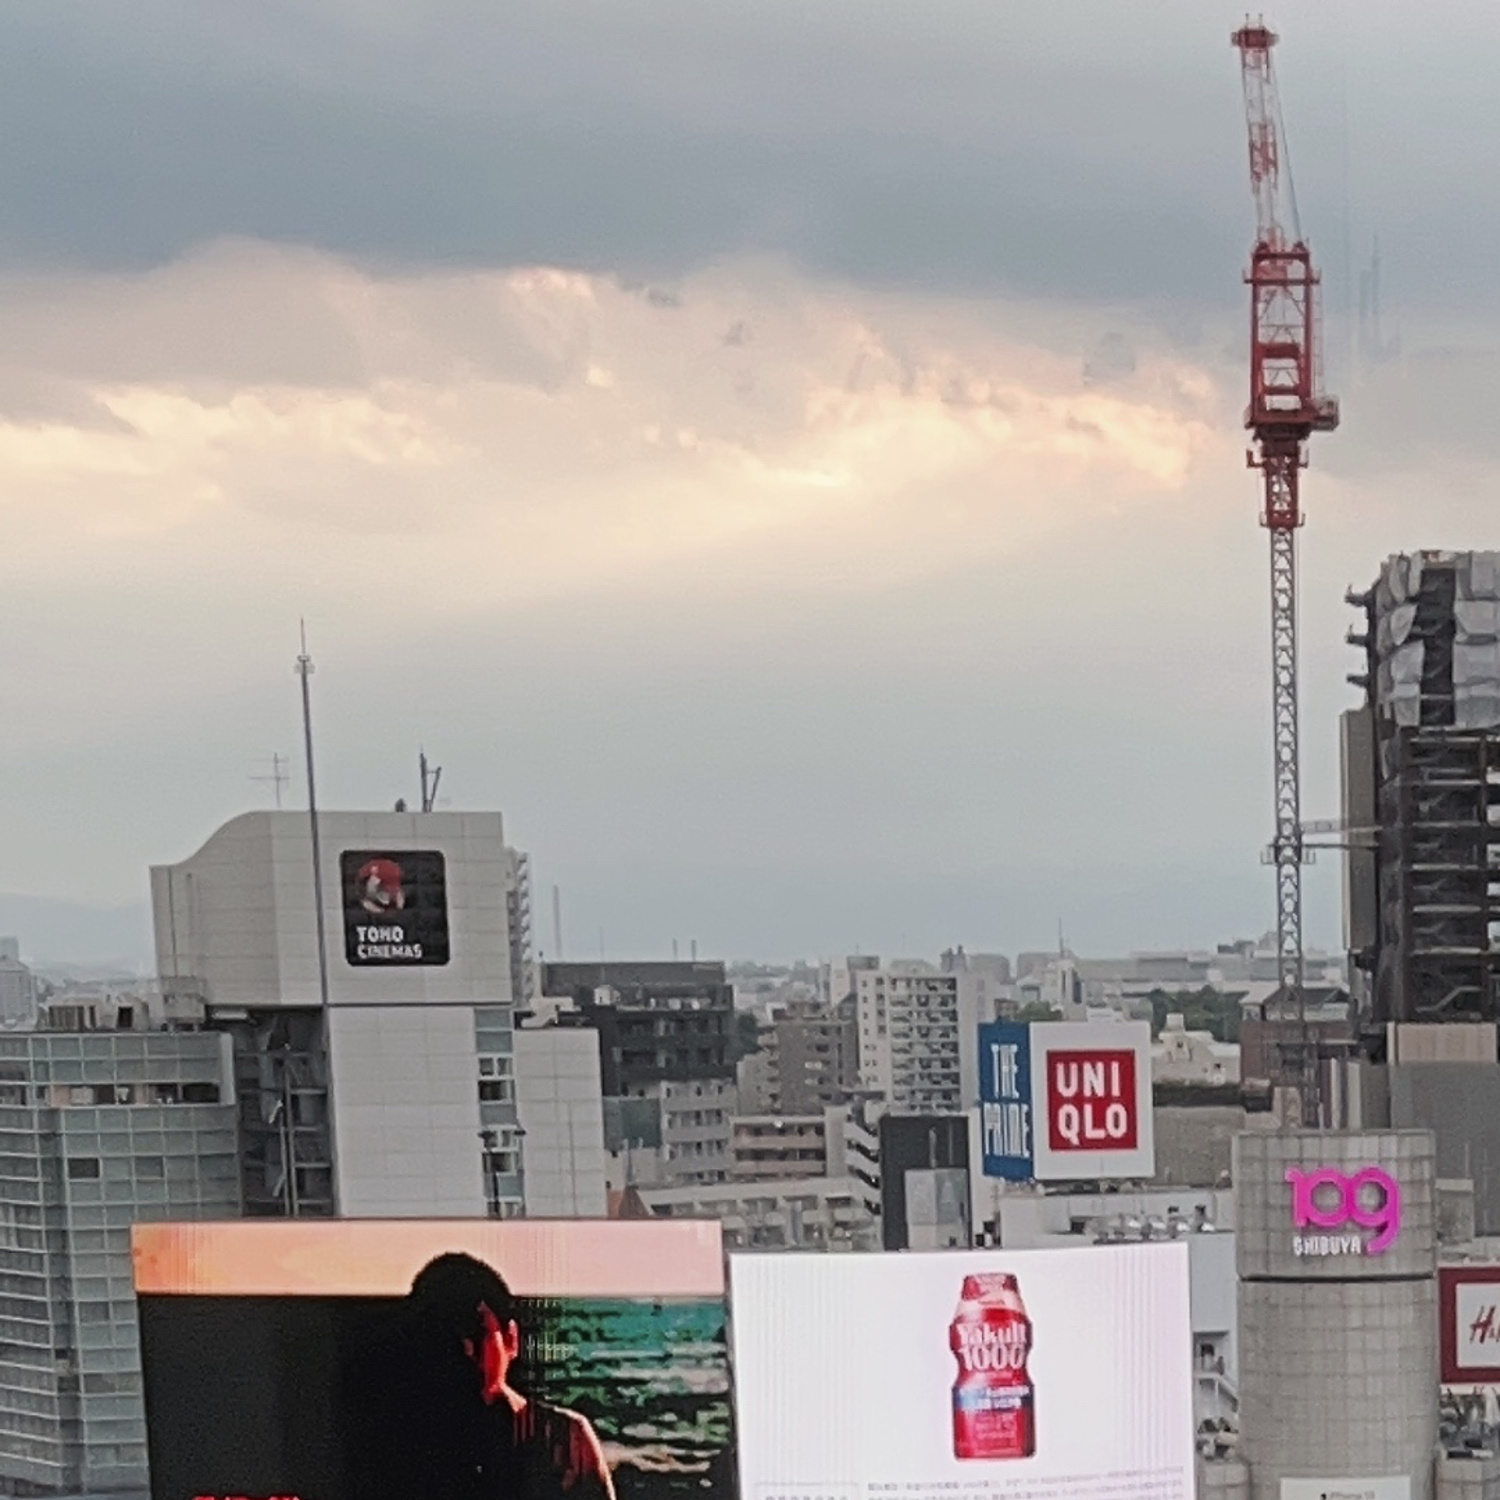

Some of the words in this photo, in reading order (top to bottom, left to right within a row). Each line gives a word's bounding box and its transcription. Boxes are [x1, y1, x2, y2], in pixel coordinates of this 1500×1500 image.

[357, 926, 403, 942] TOHO
[357, 944, 422, 959] CINEMAS
[1056, 1061, 1121, 1097] UNI
[1058, 1104, 1128, 1145] QLO
[1284, 1166, 1401, 1256] 109
[1292, 1235, 1362, 1256] SHIBUYA
[956, 1322, 1027, 1346] Yakult
[960, 1346, 1024, 1372] 1000
